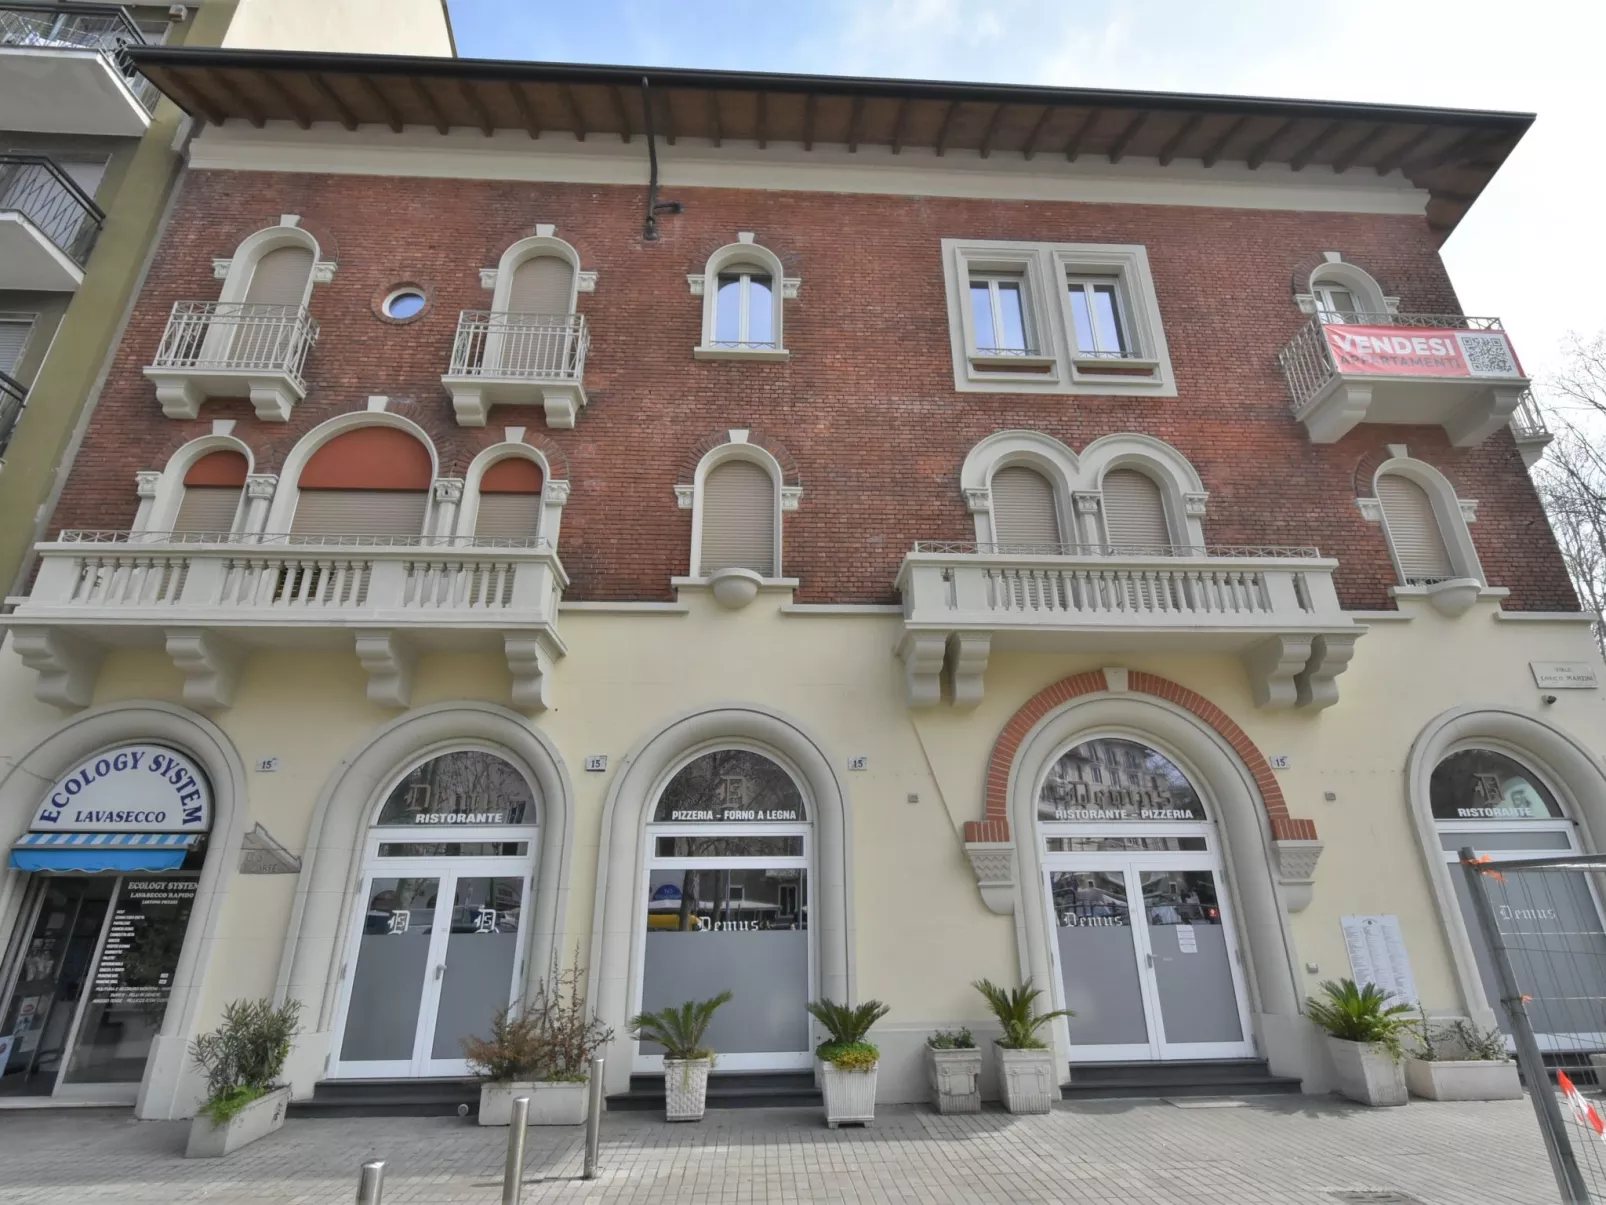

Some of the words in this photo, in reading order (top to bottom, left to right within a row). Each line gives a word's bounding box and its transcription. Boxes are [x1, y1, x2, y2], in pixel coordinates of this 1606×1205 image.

[1332, 334, 1456, 356] VENDESI
[1341, 355, 1461, 369] APPARTAMENTI
[261, 760, 273, 769] 15
[591, 759, 601, 769] 15
[853, 759, 863, 769] 15
[1275, 758, 1286, 767] 15
[39, 752, 145, 823] ECOLOGY
[148, 754, 202, 825] SYSTEM
[74, 811, 166, 823] LAVASECCO
[672, 810, 713, 820] PIZZERIA
[724, 810, 755, 820] FORNO
[757, 810, 764, 820] A
[767, 810, 797, 820] LEGNA
[1055, 809, 1127, 819] RISTORANTE
[1141, 809, 1194, 819] PIZZERIA
[1457, 807, 1533, 817] RISTORANTE
[415, 812, 503, 824] RISTORANTE
[128, 882, 168, 890] ECOLOGY
[1499, 905, 1556, 920] Demus
[698, 916, 760, 932] Demus
[1063, 911, 1123, 928] Demus
